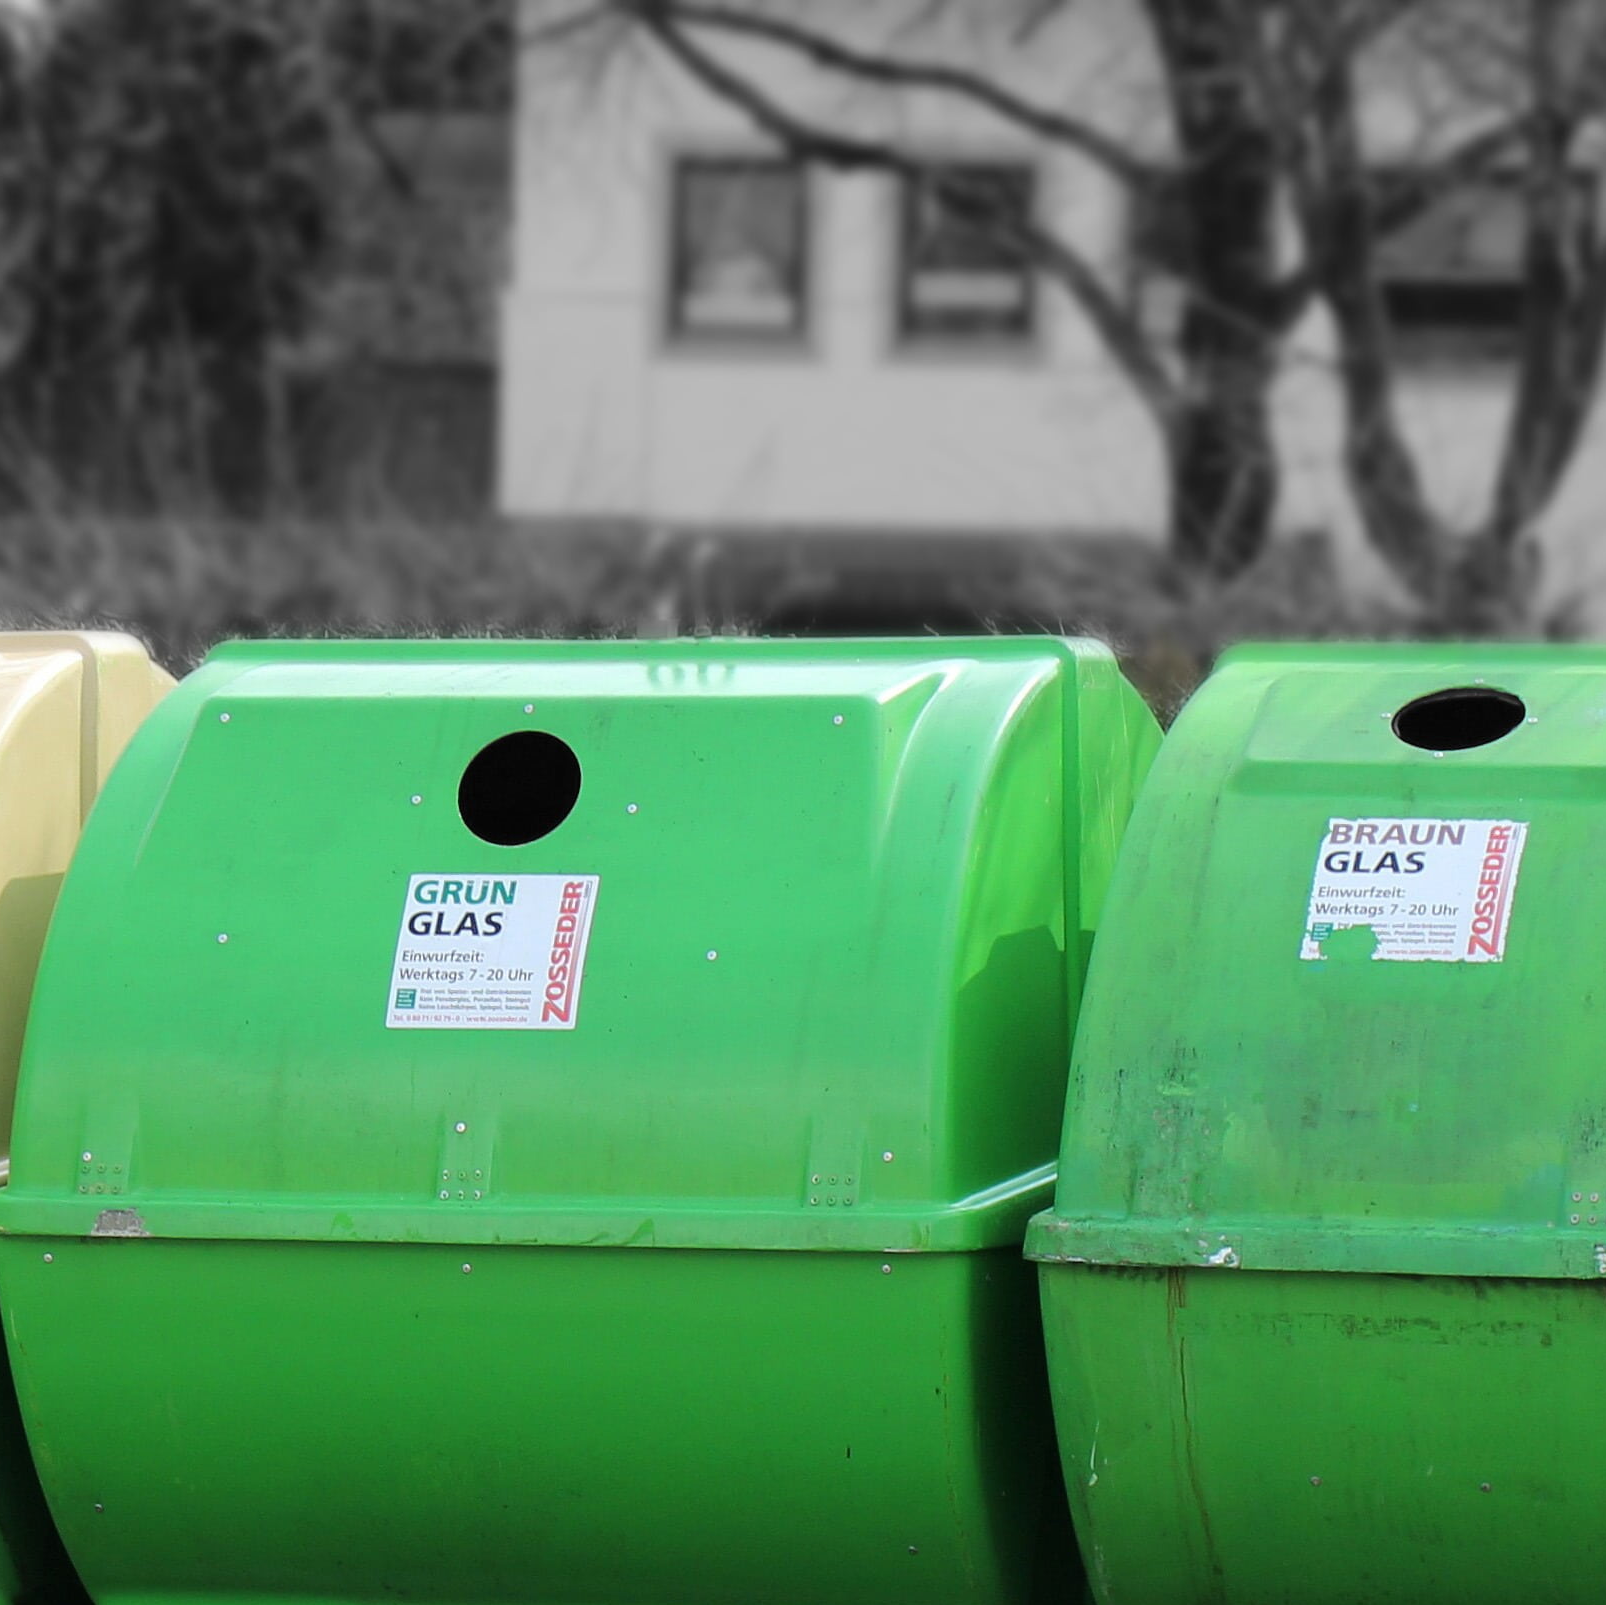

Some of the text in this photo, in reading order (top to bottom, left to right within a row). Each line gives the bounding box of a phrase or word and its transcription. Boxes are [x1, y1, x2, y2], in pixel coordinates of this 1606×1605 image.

[1329, 823, 1466, 845] BRAUN
[1324, 851, 1426, 873] GLAS
[414, 880, 517, 905] GRÜN
[1317, 886, 1406, 898] Einwurfzeit:
[1467, 825, 1512, 956] ZOSSEDER
[1314, 903, 1384, 917] Werktags
[1431, 903, 1460, 915] Uhr
[407, 911, 504, 937] GLAS
[401, 949, 484, 963] Einwurfzeit:
[541, 881, 584, 1022] ZOSSEDER
[399, 968, 464, 984] Werktags
[508, 968, 534, 981] Uhr
